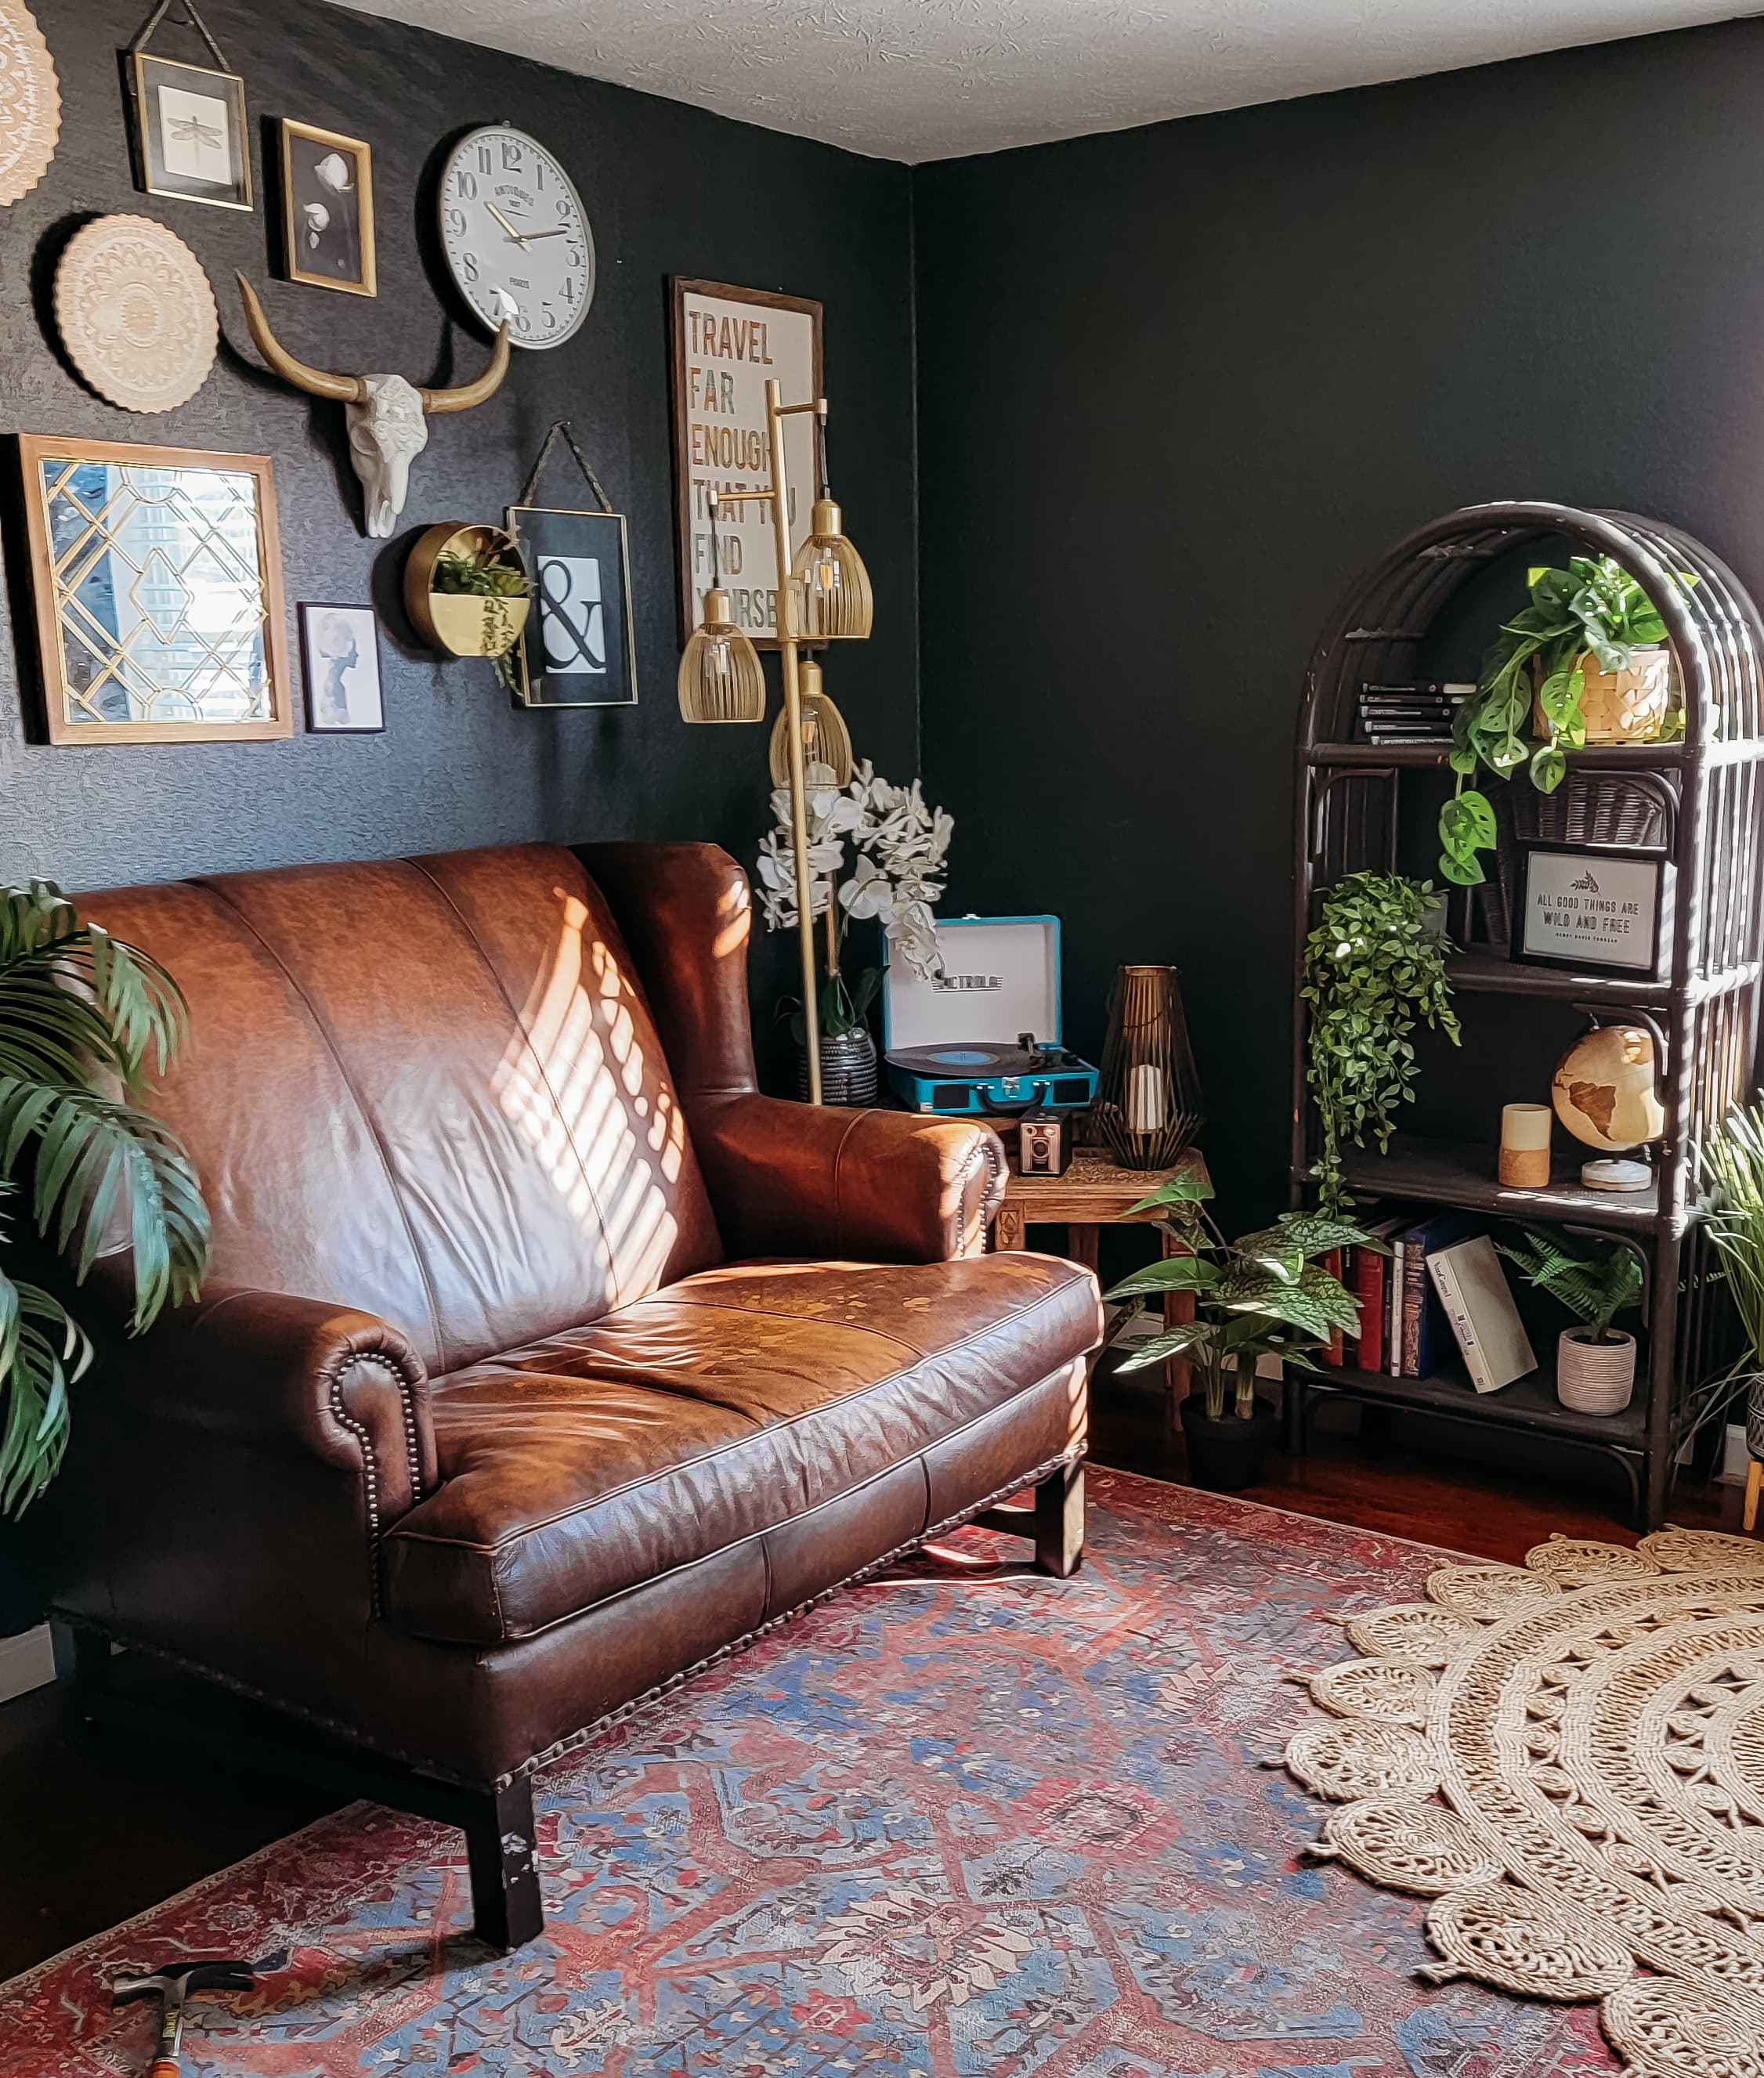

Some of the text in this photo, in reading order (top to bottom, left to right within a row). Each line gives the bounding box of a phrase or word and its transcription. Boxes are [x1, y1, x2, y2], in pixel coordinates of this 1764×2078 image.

[478, 146, 491, 175] 11
[502, 143, 522, 173] 12
[457, 171, 477, 200] 10
[537, 164, 544, 190] 1
[450, 209, 467, 237] 9
[556, 200, 571, 228] 2
[463, 253, 479, 282] 8
[566, 240, 580, 267] 3
[558, 277, 574, 305] 4
[514, 305, 531, 332] 6
[541, 302, 555, 329] 5
[689, 310, 773, 365] TRAVEL
[689, 368, 735, 414] FAR
[539, 560, 606, 670] &
[1538, 894, 1639, 916] ALL GOOD THINGS ARE
[1543, 911, 1630, 934] WILD AND FREE
